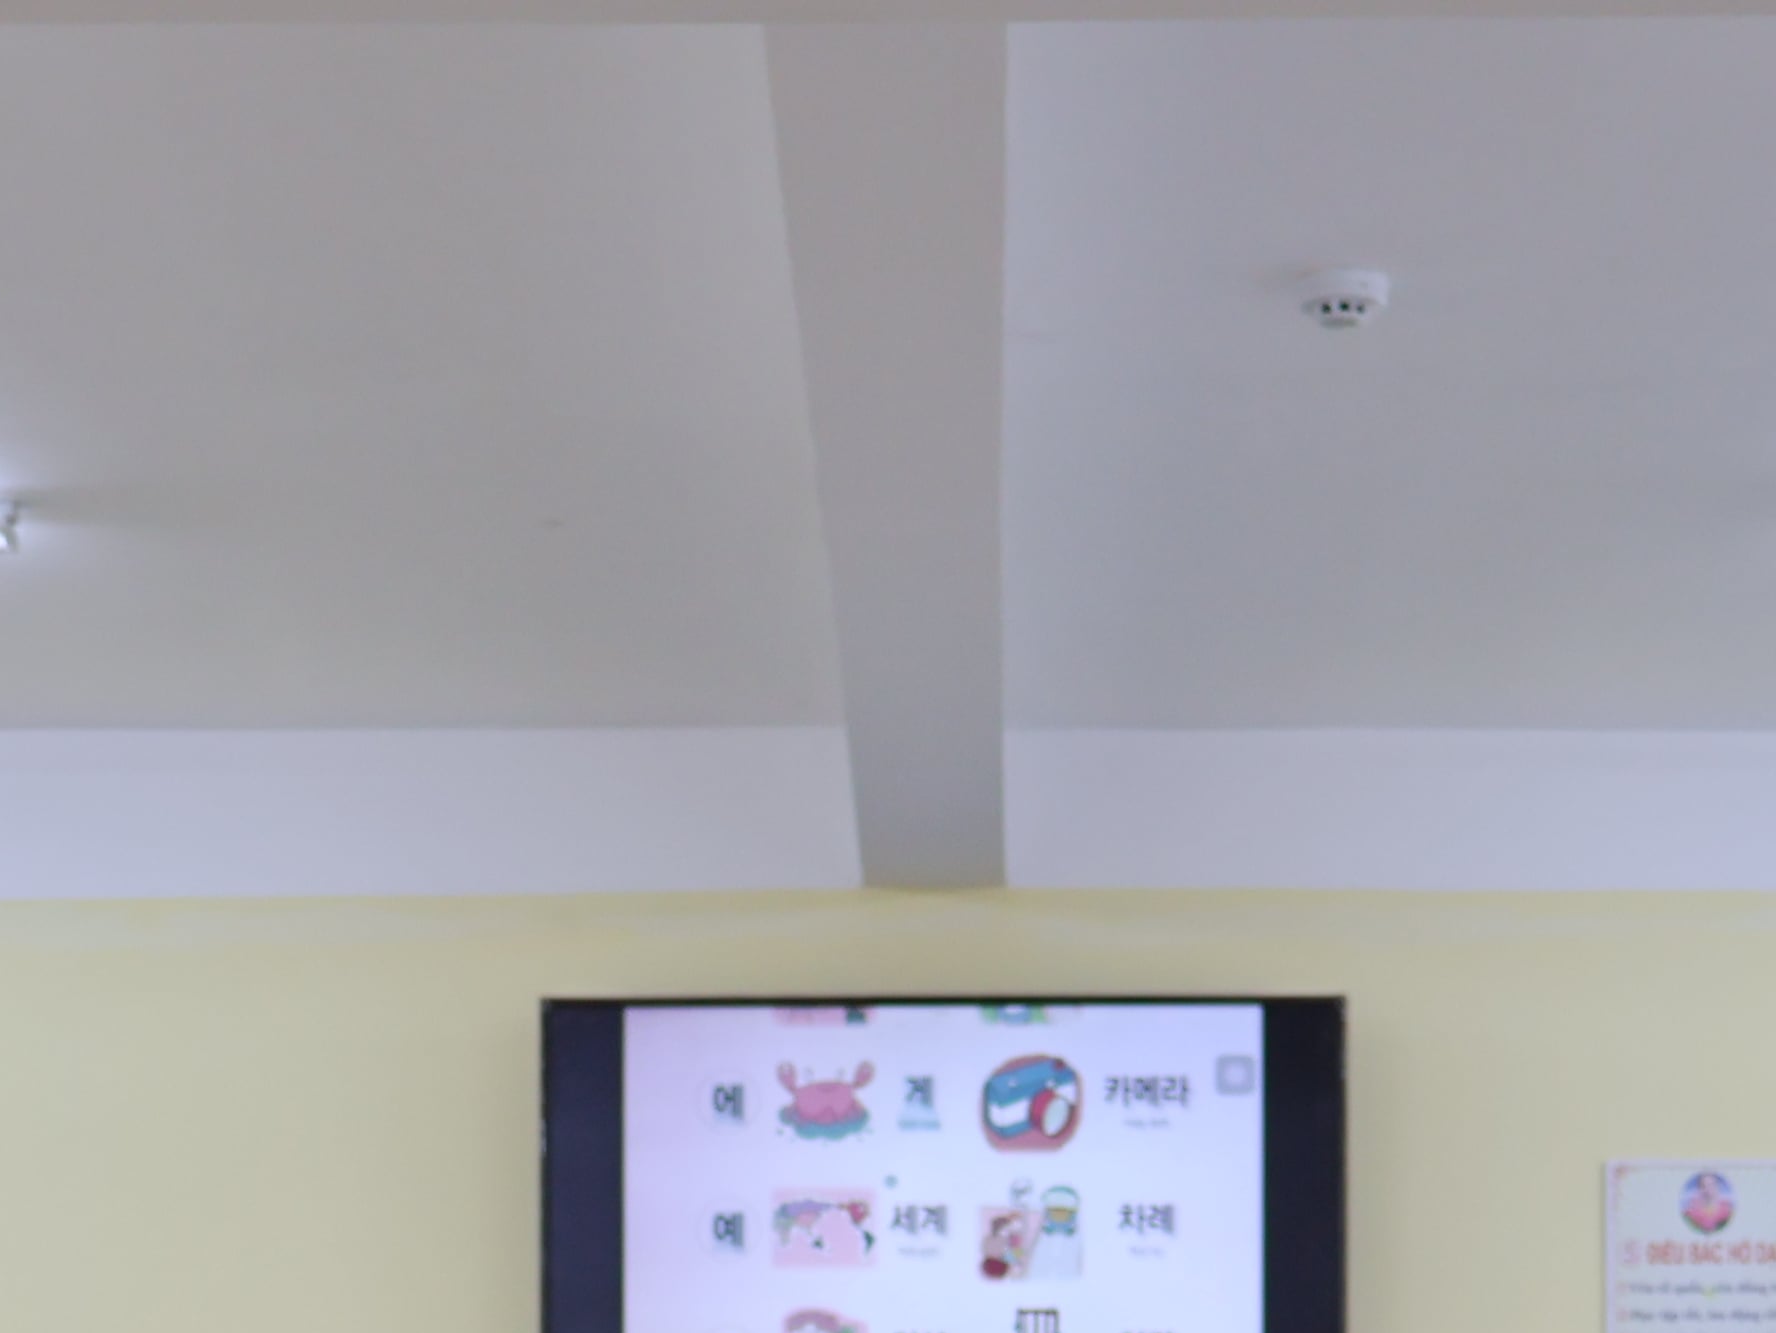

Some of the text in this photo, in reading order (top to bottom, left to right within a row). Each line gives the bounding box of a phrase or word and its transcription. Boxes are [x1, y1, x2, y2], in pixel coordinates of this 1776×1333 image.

[712, 1085, 744, 1118] 에
[1104, 1076, 1191, 1107] 카메라
[889, 1205, 948, 1236] 세계
